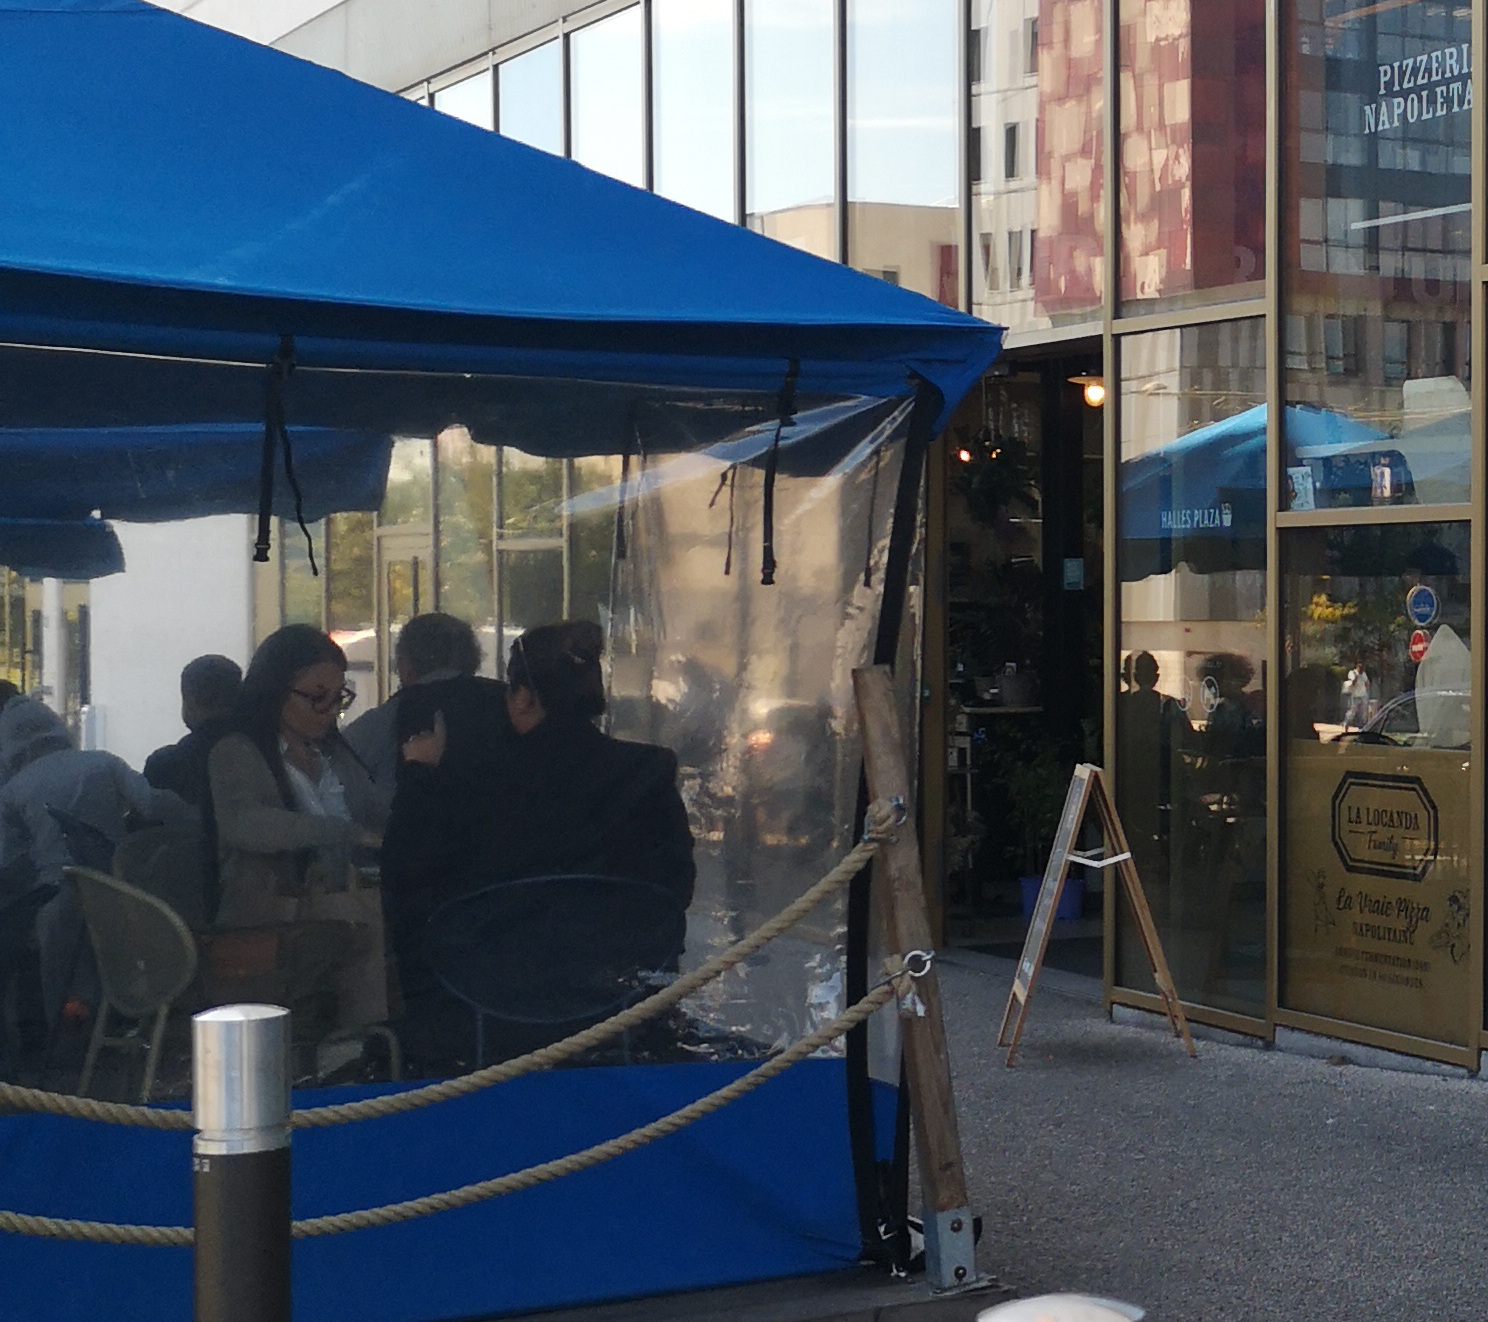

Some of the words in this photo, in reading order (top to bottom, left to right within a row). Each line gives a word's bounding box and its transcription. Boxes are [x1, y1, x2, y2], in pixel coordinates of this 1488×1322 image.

[1379, 43, 1472, 95] PIZZERI
[1161, 509, 1192, 529] HALLES
[1193, 507, 1221, 528] PLAZA
[1347, 805, 1362, 825] LA
[1366, 807, 1420, 831] LOCANDA
[1336, 887, 1353, 911] La
[1358, 891, 1393, 918] Vraie
